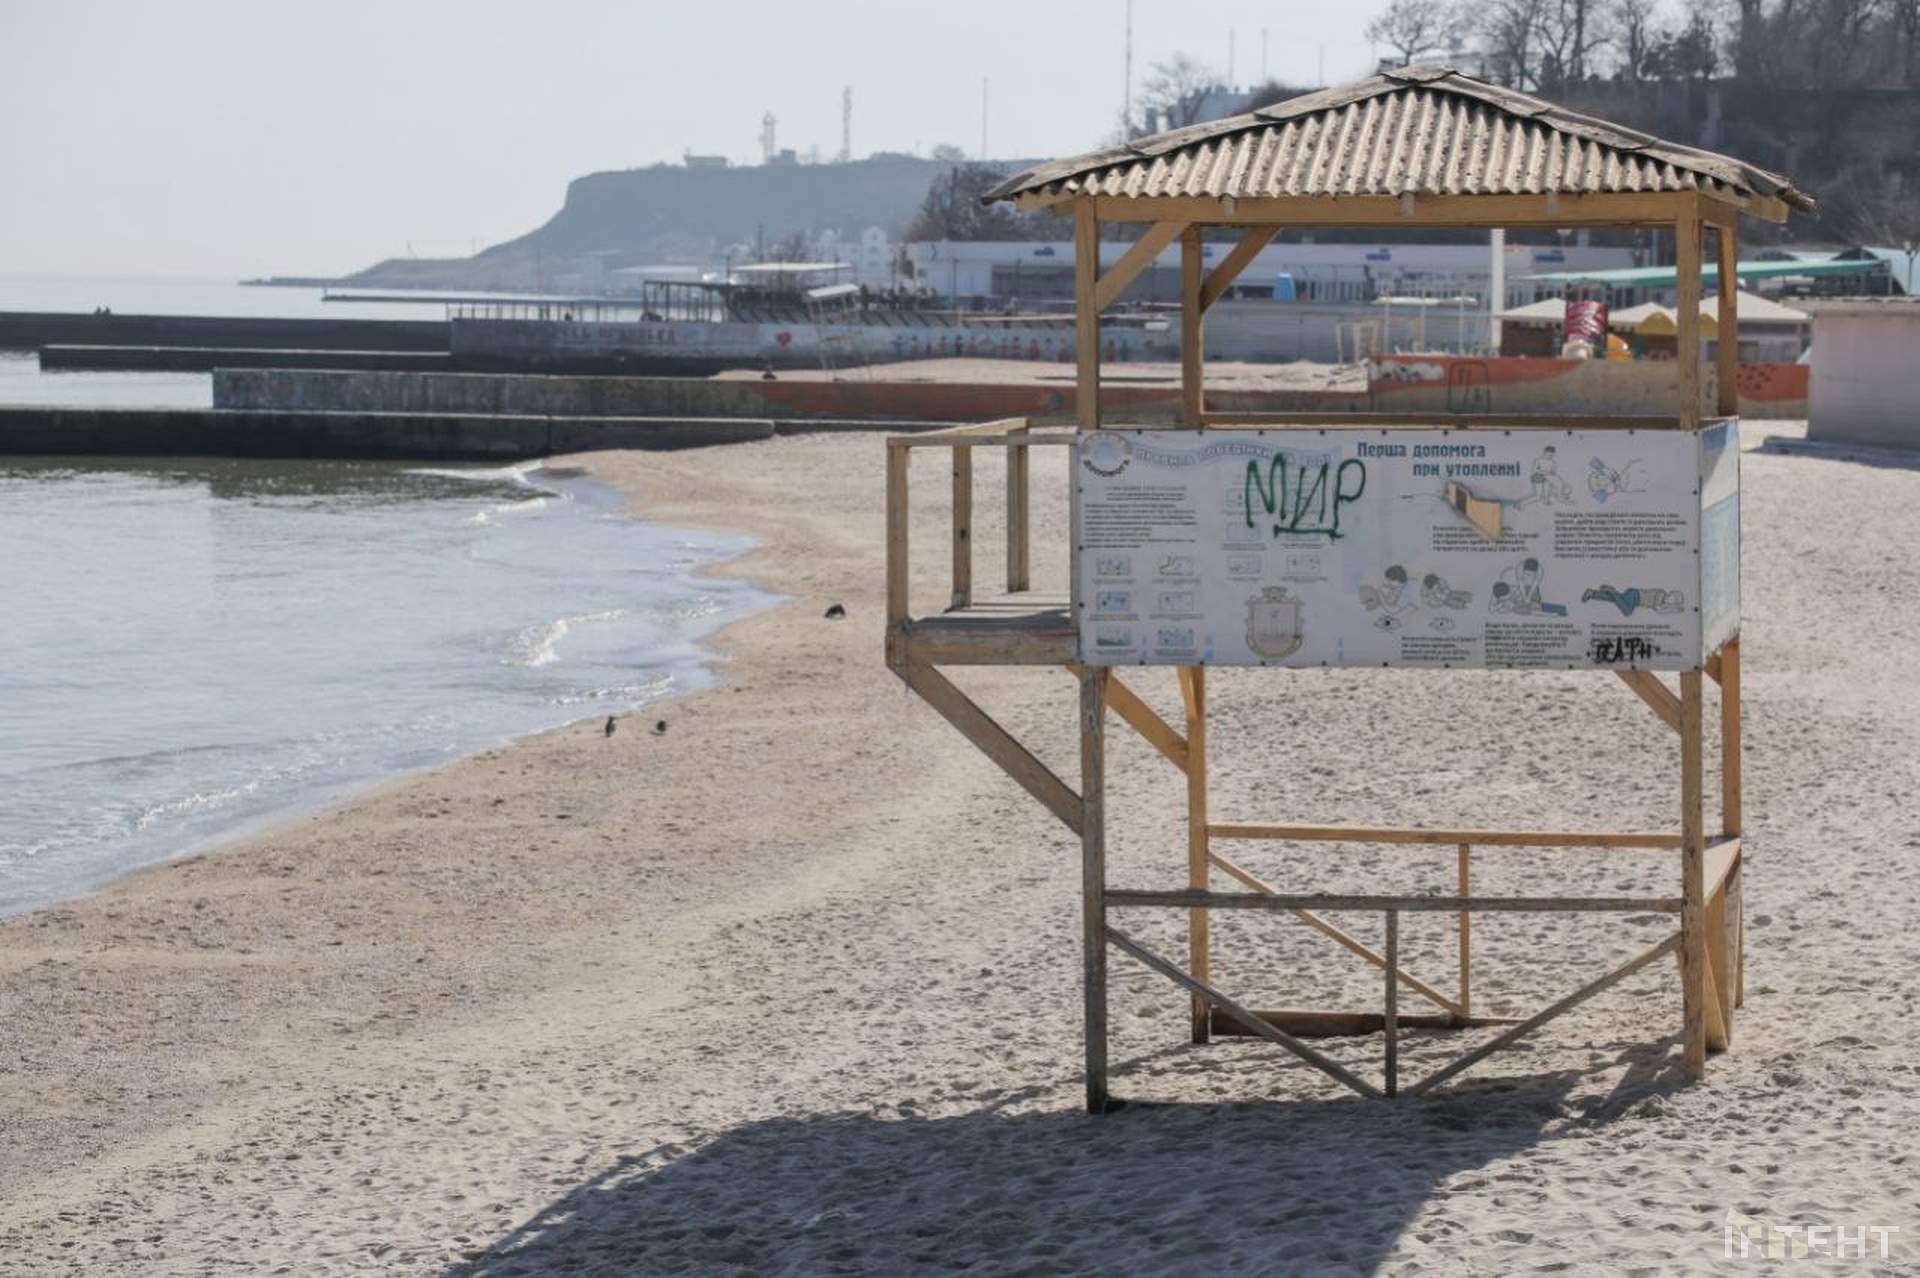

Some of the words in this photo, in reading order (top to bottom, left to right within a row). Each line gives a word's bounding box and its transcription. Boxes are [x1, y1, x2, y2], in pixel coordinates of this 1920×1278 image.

[1357, 442, 1407, 459] Перша
[1412, 444, 1486, 458] допомога
[1413, 463, 1440, 477] при
[1445, 461, 1521, 477] утопленні
[1245, 453, 1366, 530] МИР
